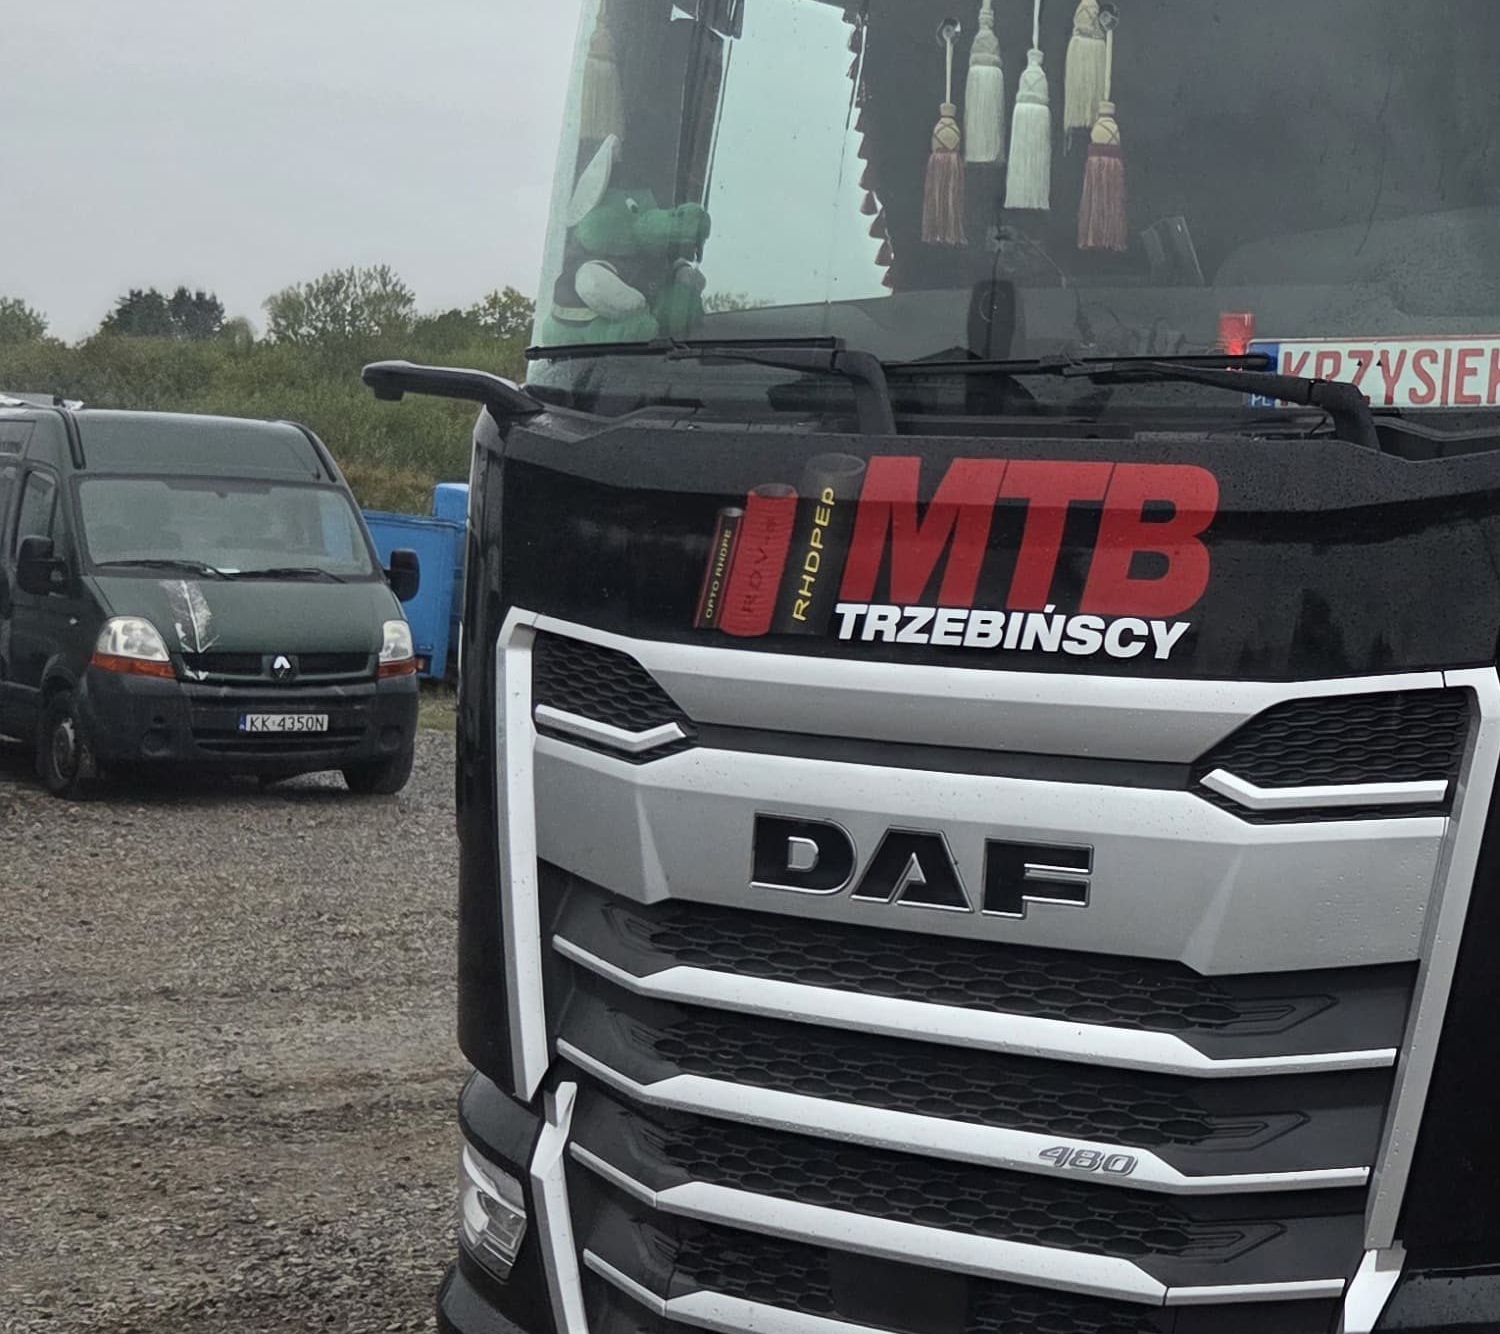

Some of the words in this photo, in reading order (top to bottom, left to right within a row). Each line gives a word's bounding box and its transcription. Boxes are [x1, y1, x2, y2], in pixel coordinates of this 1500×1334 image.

[838, 455, 1220, 620] MTB
[705, 581, 720, 619] OPTO
[834, 603, 1191, 660] TRZEBIŃSCY
[750, 810, 1094, 920] DAF
[1038, 1145, 1139, 1177] 480
